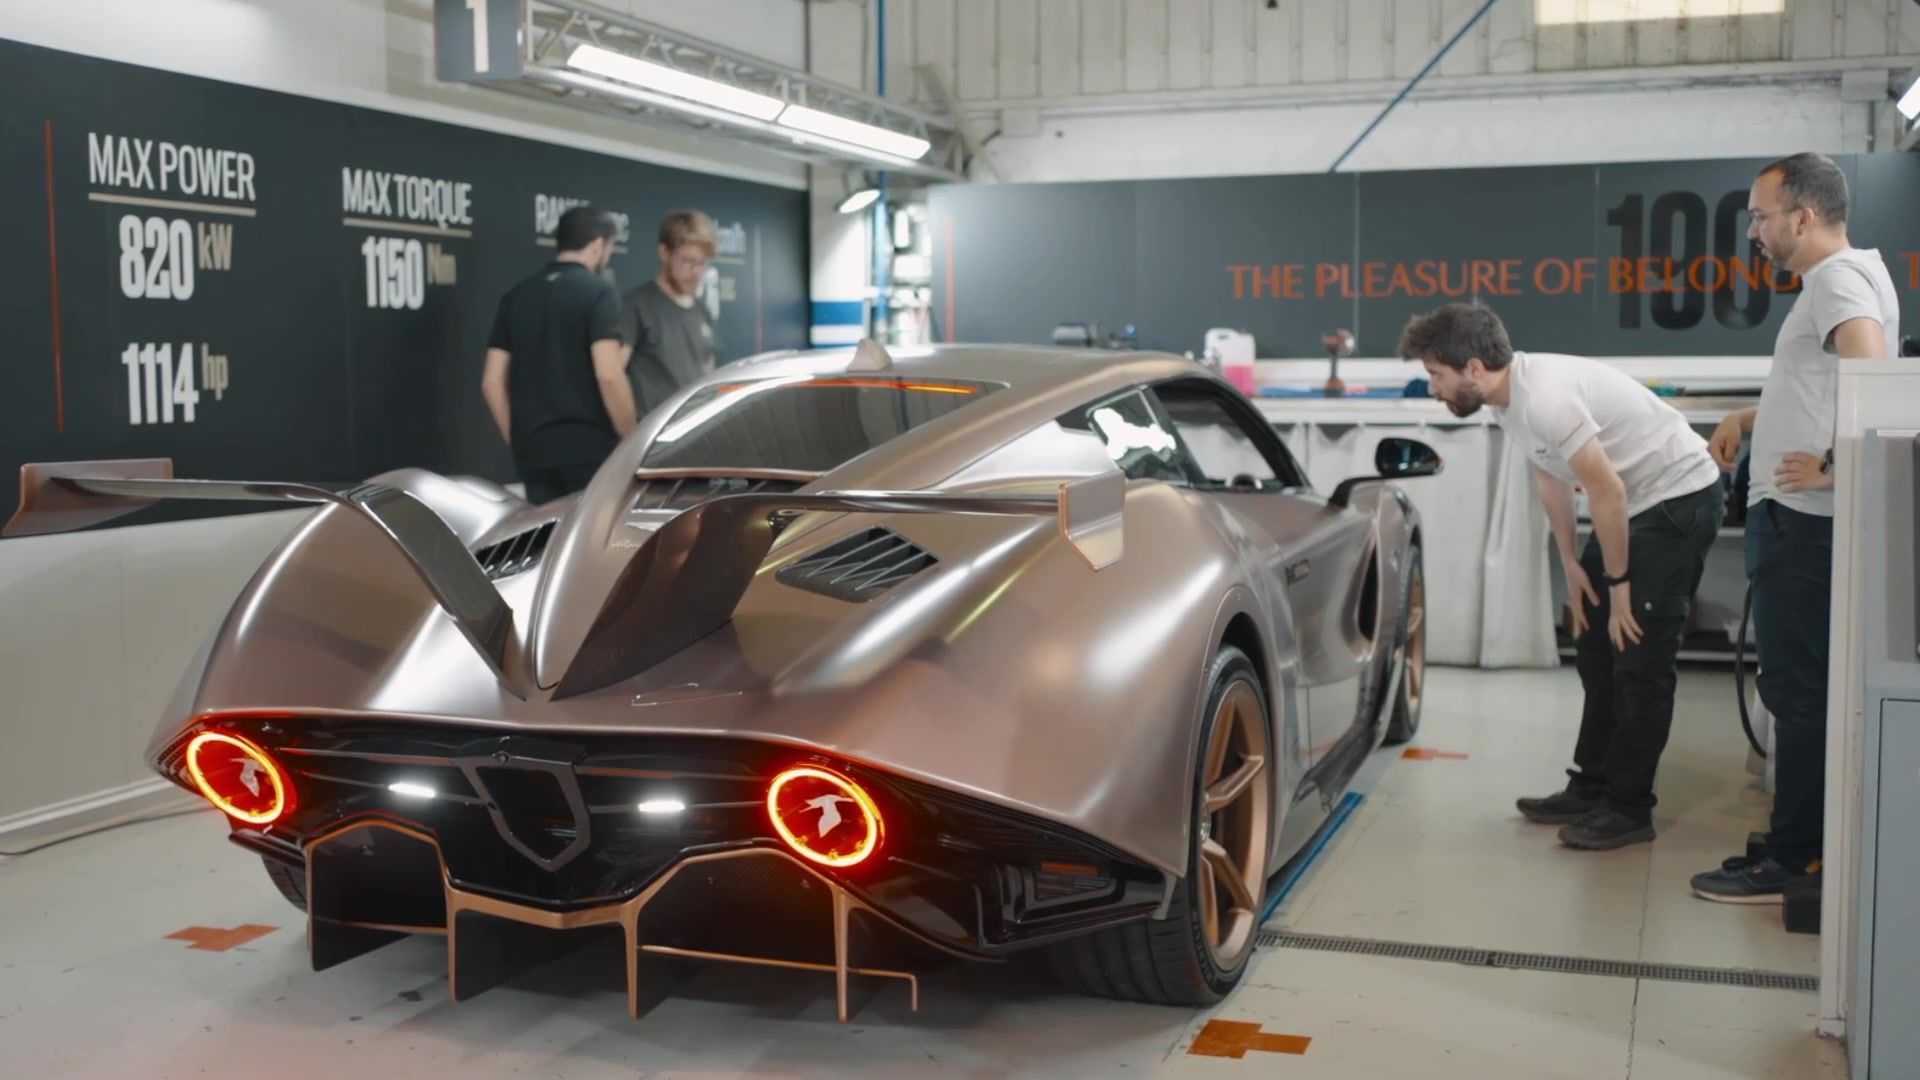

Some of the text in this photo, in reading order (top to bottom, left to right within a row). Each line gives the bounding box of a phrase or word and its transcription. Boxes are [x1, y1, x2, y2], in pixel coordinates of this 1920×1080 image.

[465, 0, 490, 74] 1
[88, 132, 256, 202] MAX POWER
[342, 167, 473, 231] MAX TORQUE
[119, 214, 233, 301] 820 kW
[361, 235, 425, 311] 1150
[1226, 263, 1305, 299] THE
[1315, 259, 1523, 298] PLEASURE
[1533, 257, 1598, 296] OF
[1608, 254, 1802, 294] BELONG
[1607, 190, 1803, 331] 190
[121, 342, 229, 425] 1114 hp
